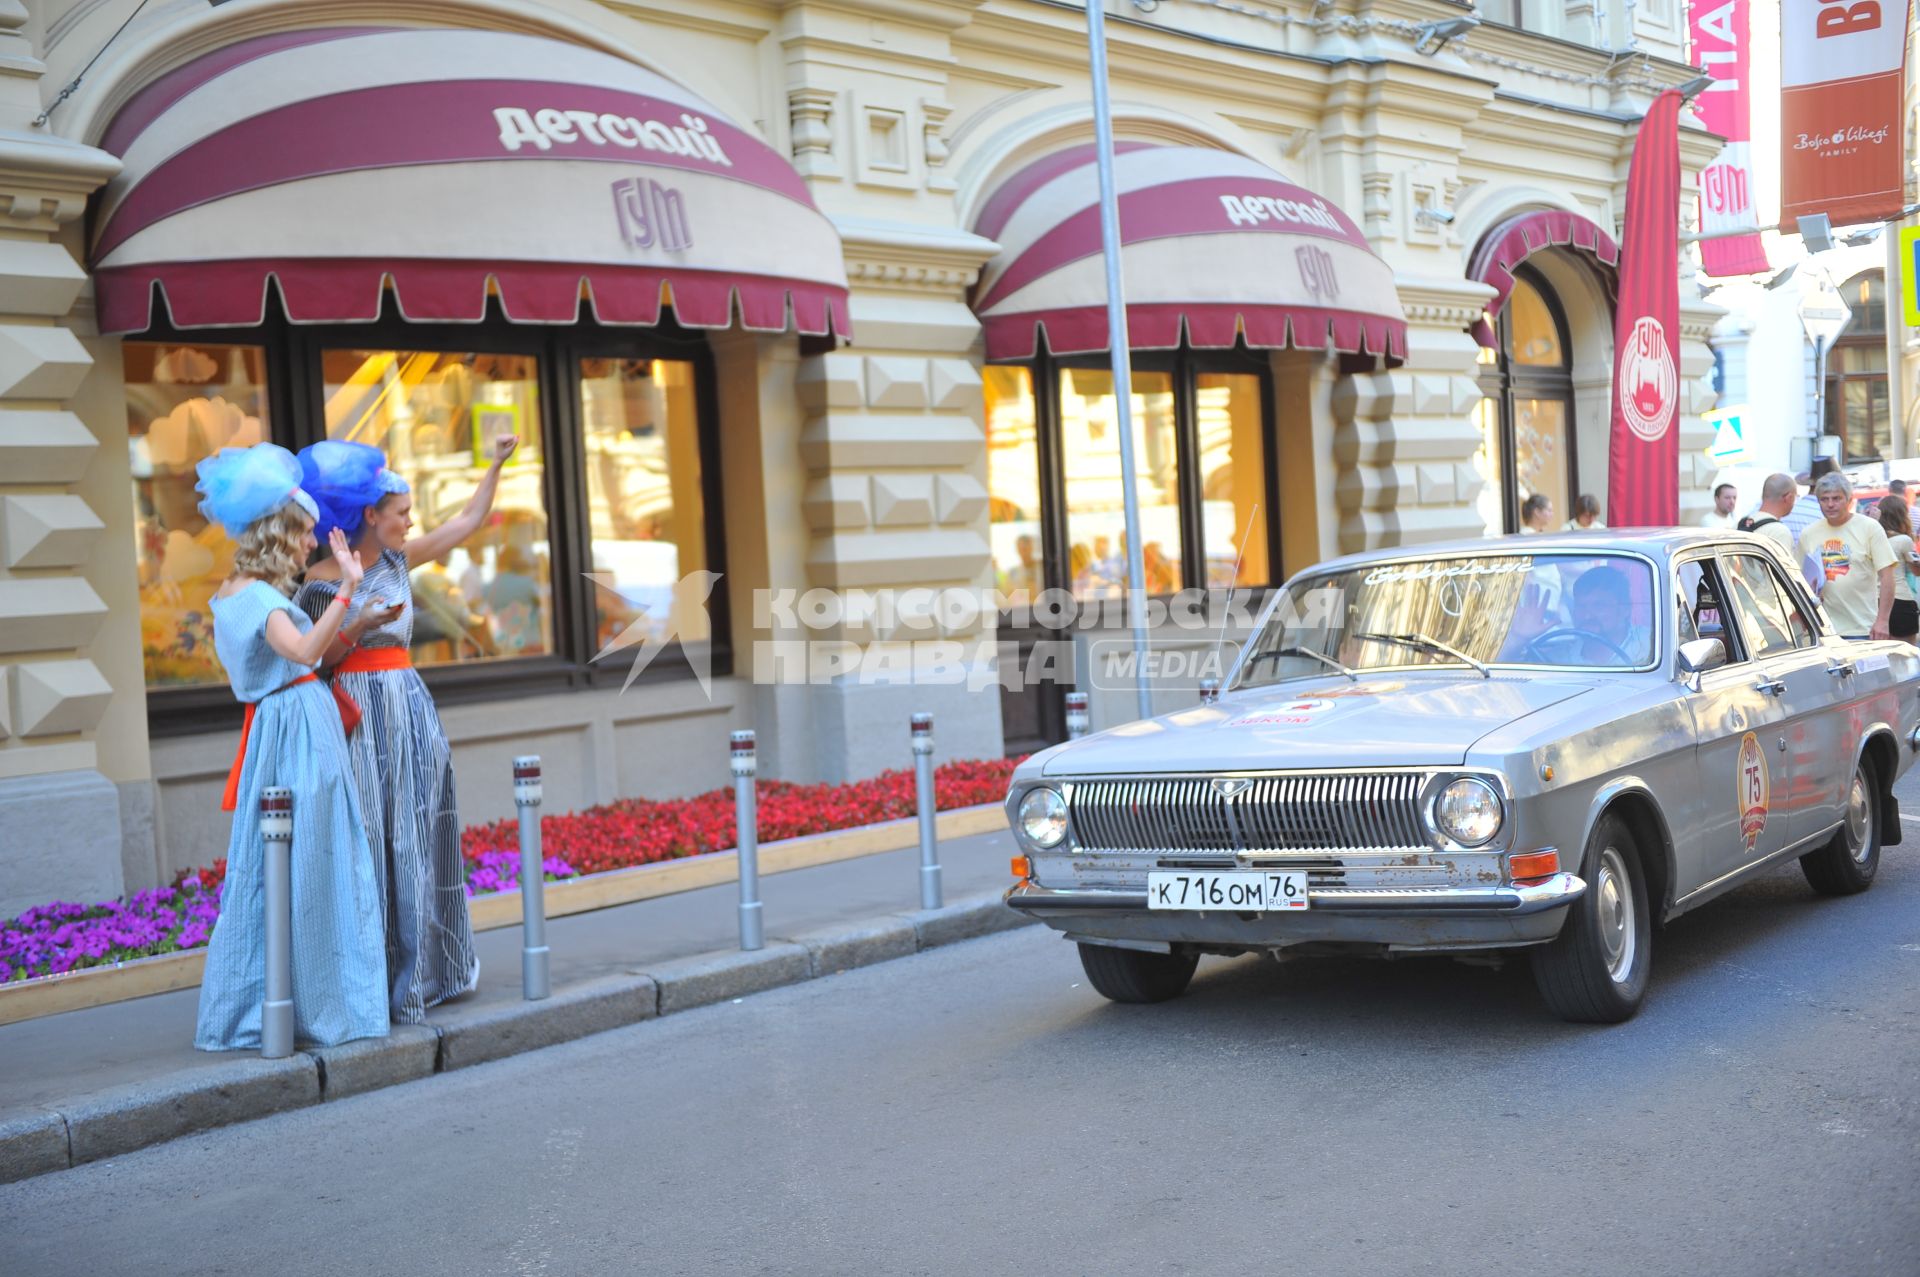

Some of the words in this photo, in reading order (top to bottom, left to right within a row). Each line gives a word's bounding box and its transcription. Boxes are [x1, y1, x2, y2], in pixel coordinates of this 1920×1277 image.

[1816, 0, 1881, 38] B
[1820, 147, 1858, 158] FAMILY
[1704, 164, 1749, 216] ГУМ
[611, 177, 693, 252] ГУМ
[1294, 244, 1340, 299] ГУМ
[1637, 321, 1662, 360] ГУМ
[1745, 766, 1761, 804] 75
[1159, 877, 1263, 905] К716ОМ
[1269, 876, 1297, 898] 76
[1268, 898, 1289, 907] RUS
